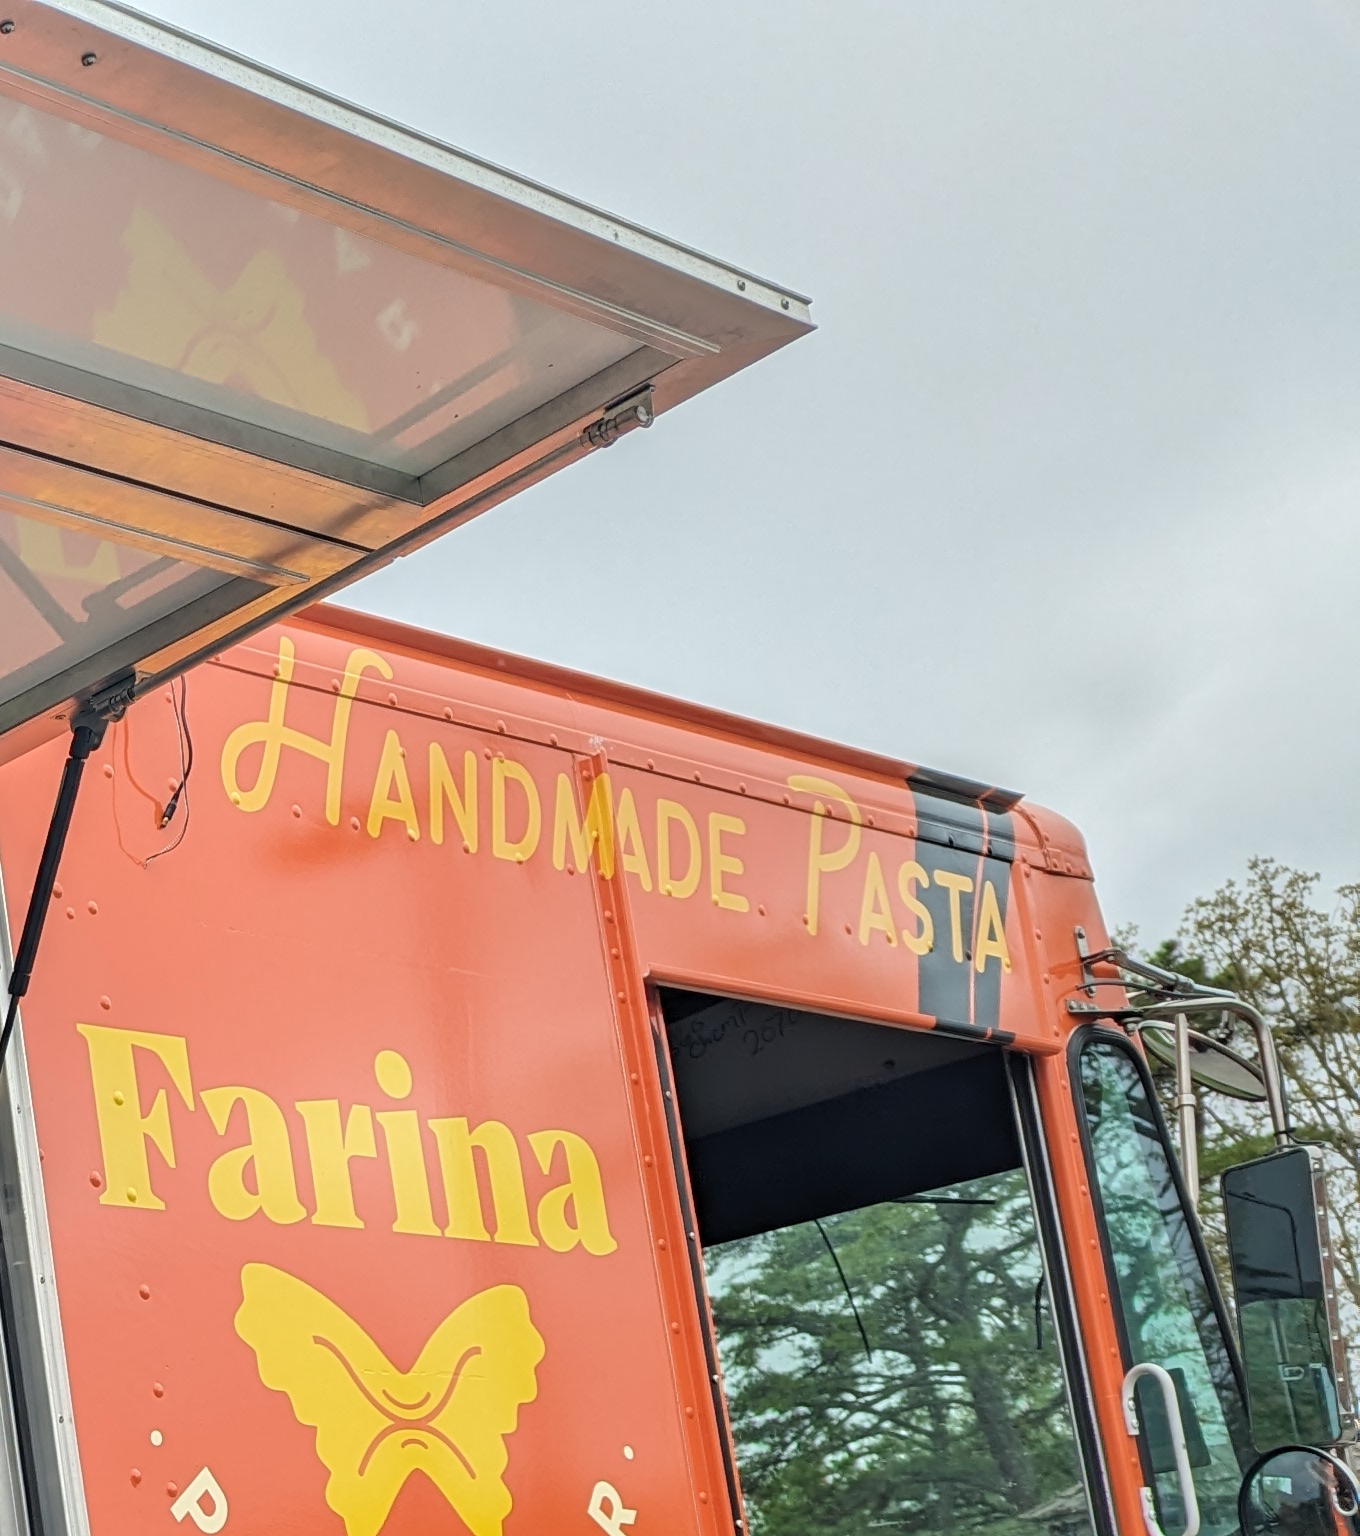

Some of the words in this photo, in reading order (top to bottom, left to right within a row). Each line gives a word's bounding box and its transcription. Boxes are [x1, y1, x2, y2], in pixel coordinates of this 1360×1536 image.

[220, 636, 750, 912] HANDMADE
[787, 775, 1012, 974] PASTA
[78, 1023, 617, 1256] Farina
